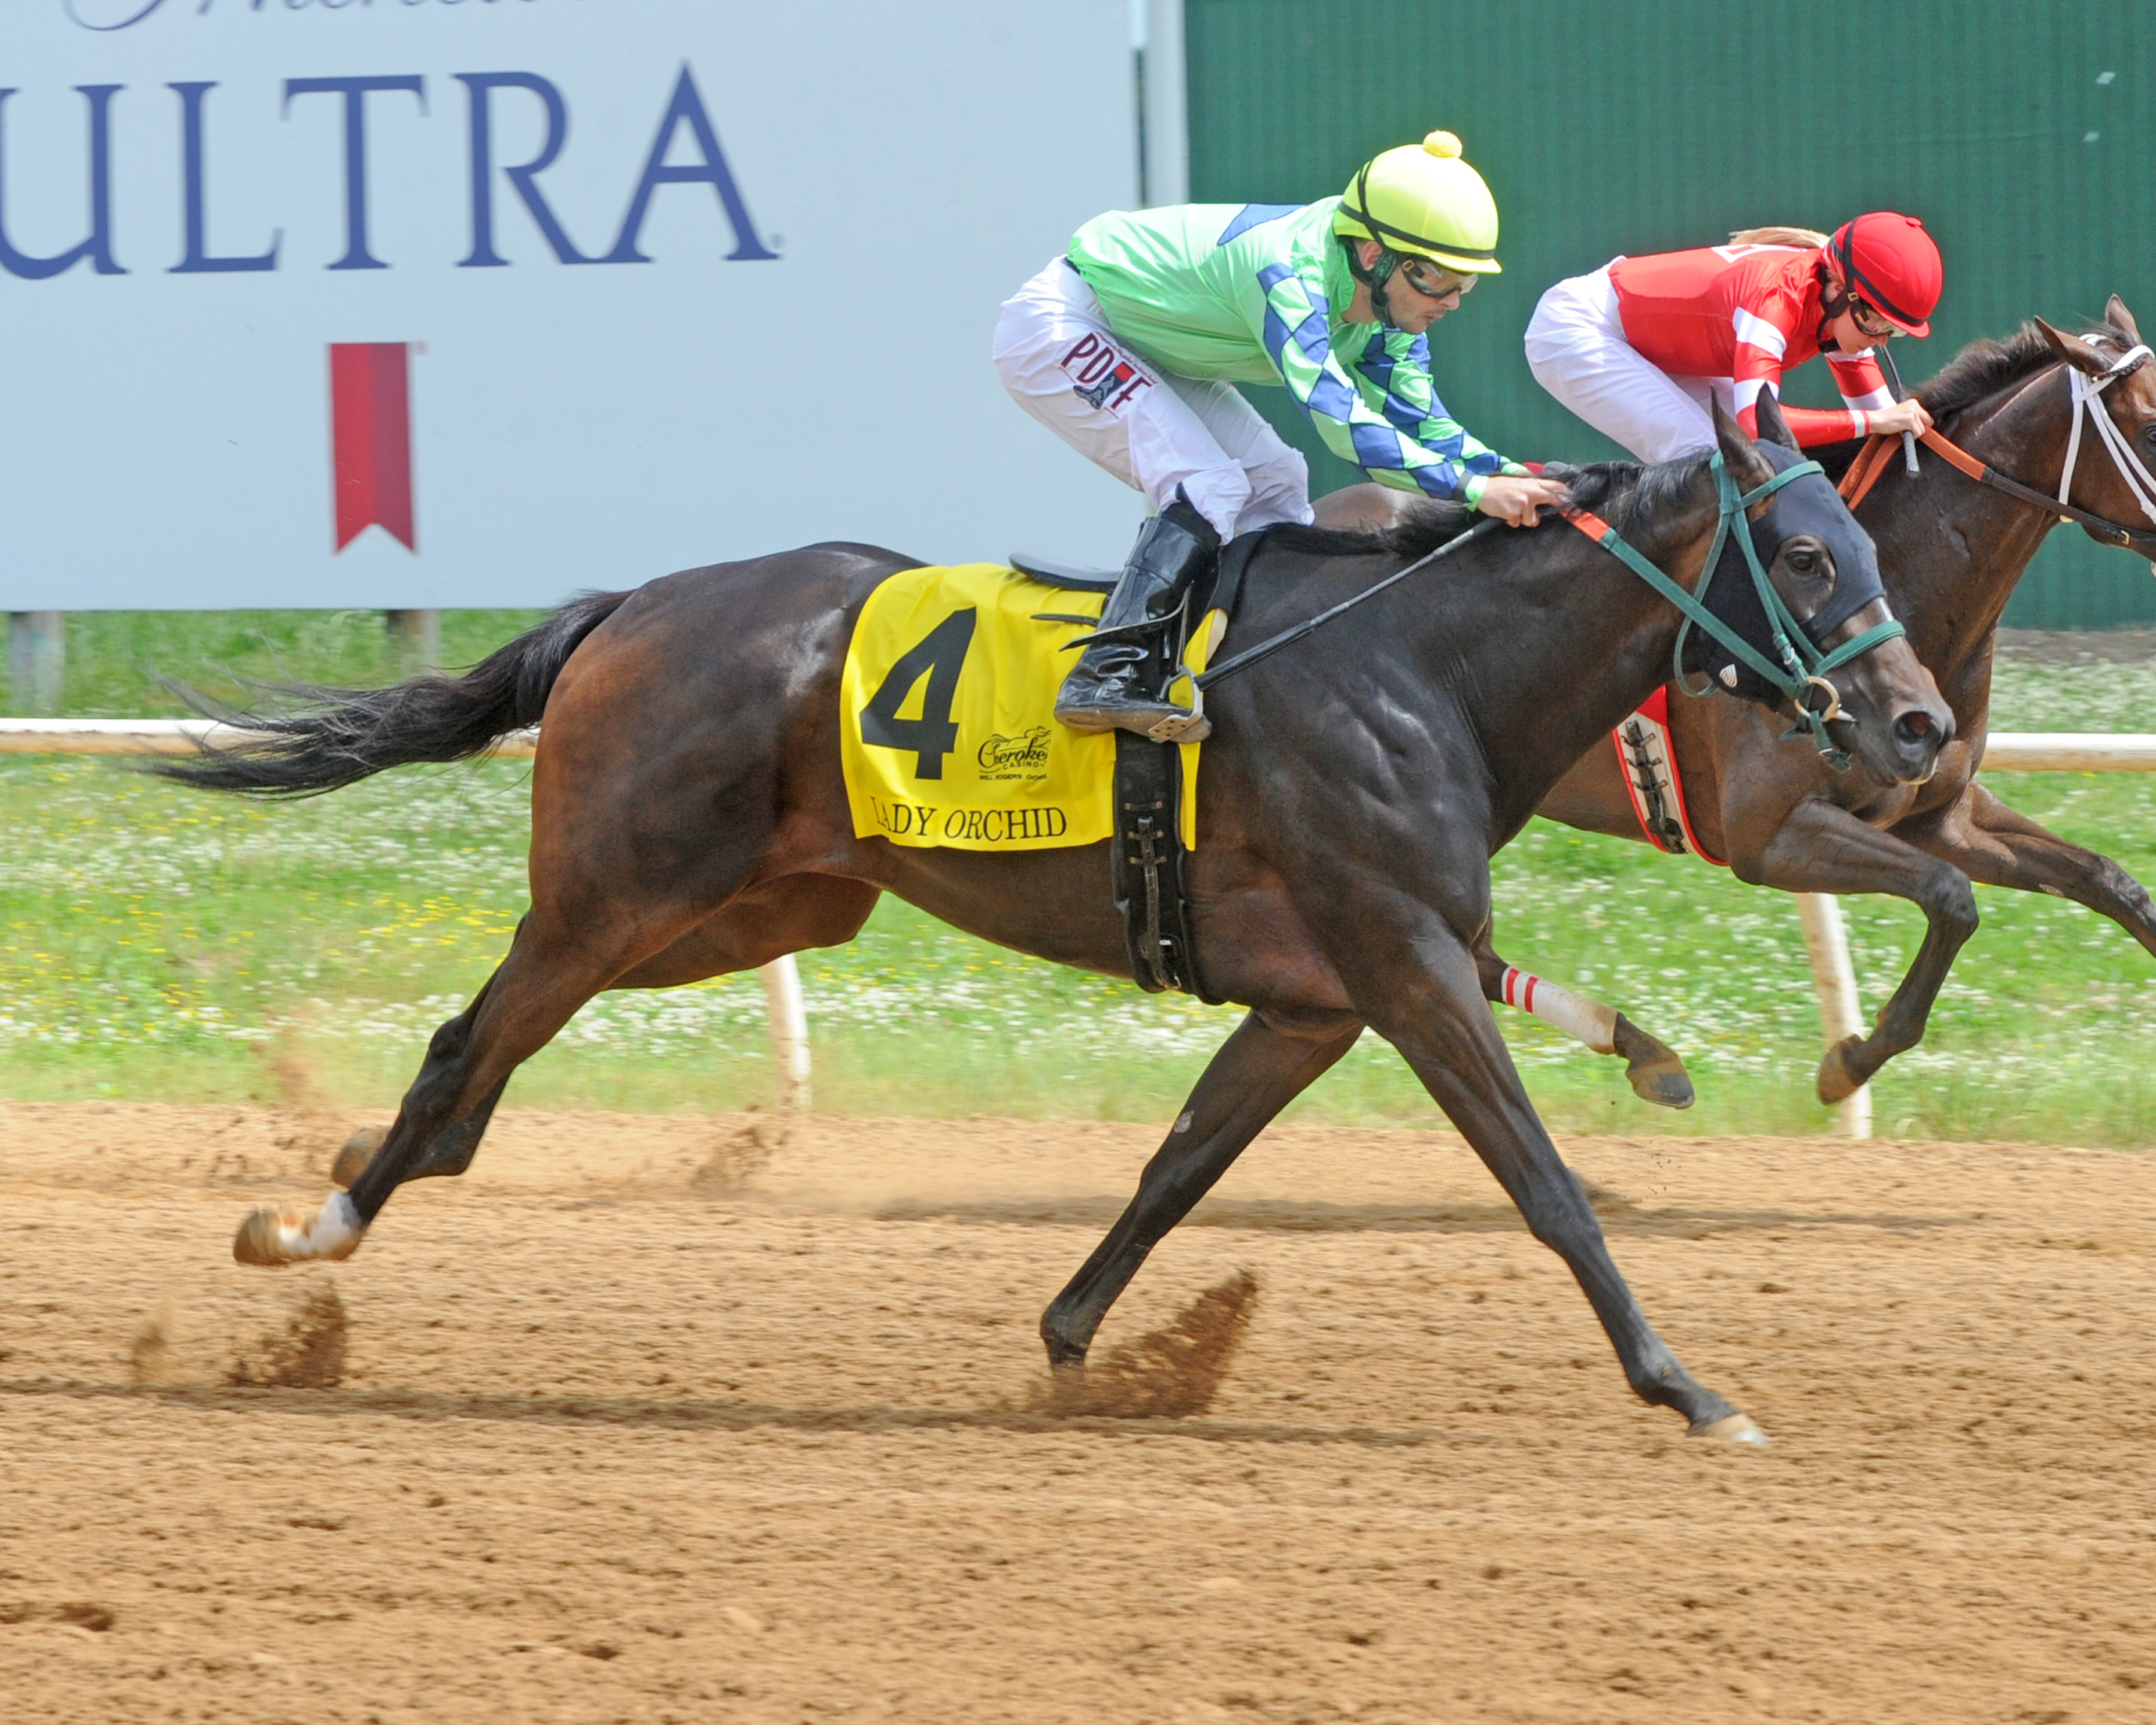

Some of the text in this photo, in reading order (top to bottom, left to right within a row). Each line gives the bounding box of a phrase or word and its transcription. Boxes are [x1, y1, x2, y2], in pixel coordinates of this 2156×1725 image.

[0, 60, 783, 280] ULTRA
[859, 606, 977, 780] 4
[870, 796, 1067, 842] LADY ORCHID
[1003, 761, 1039, 770] CASINO
